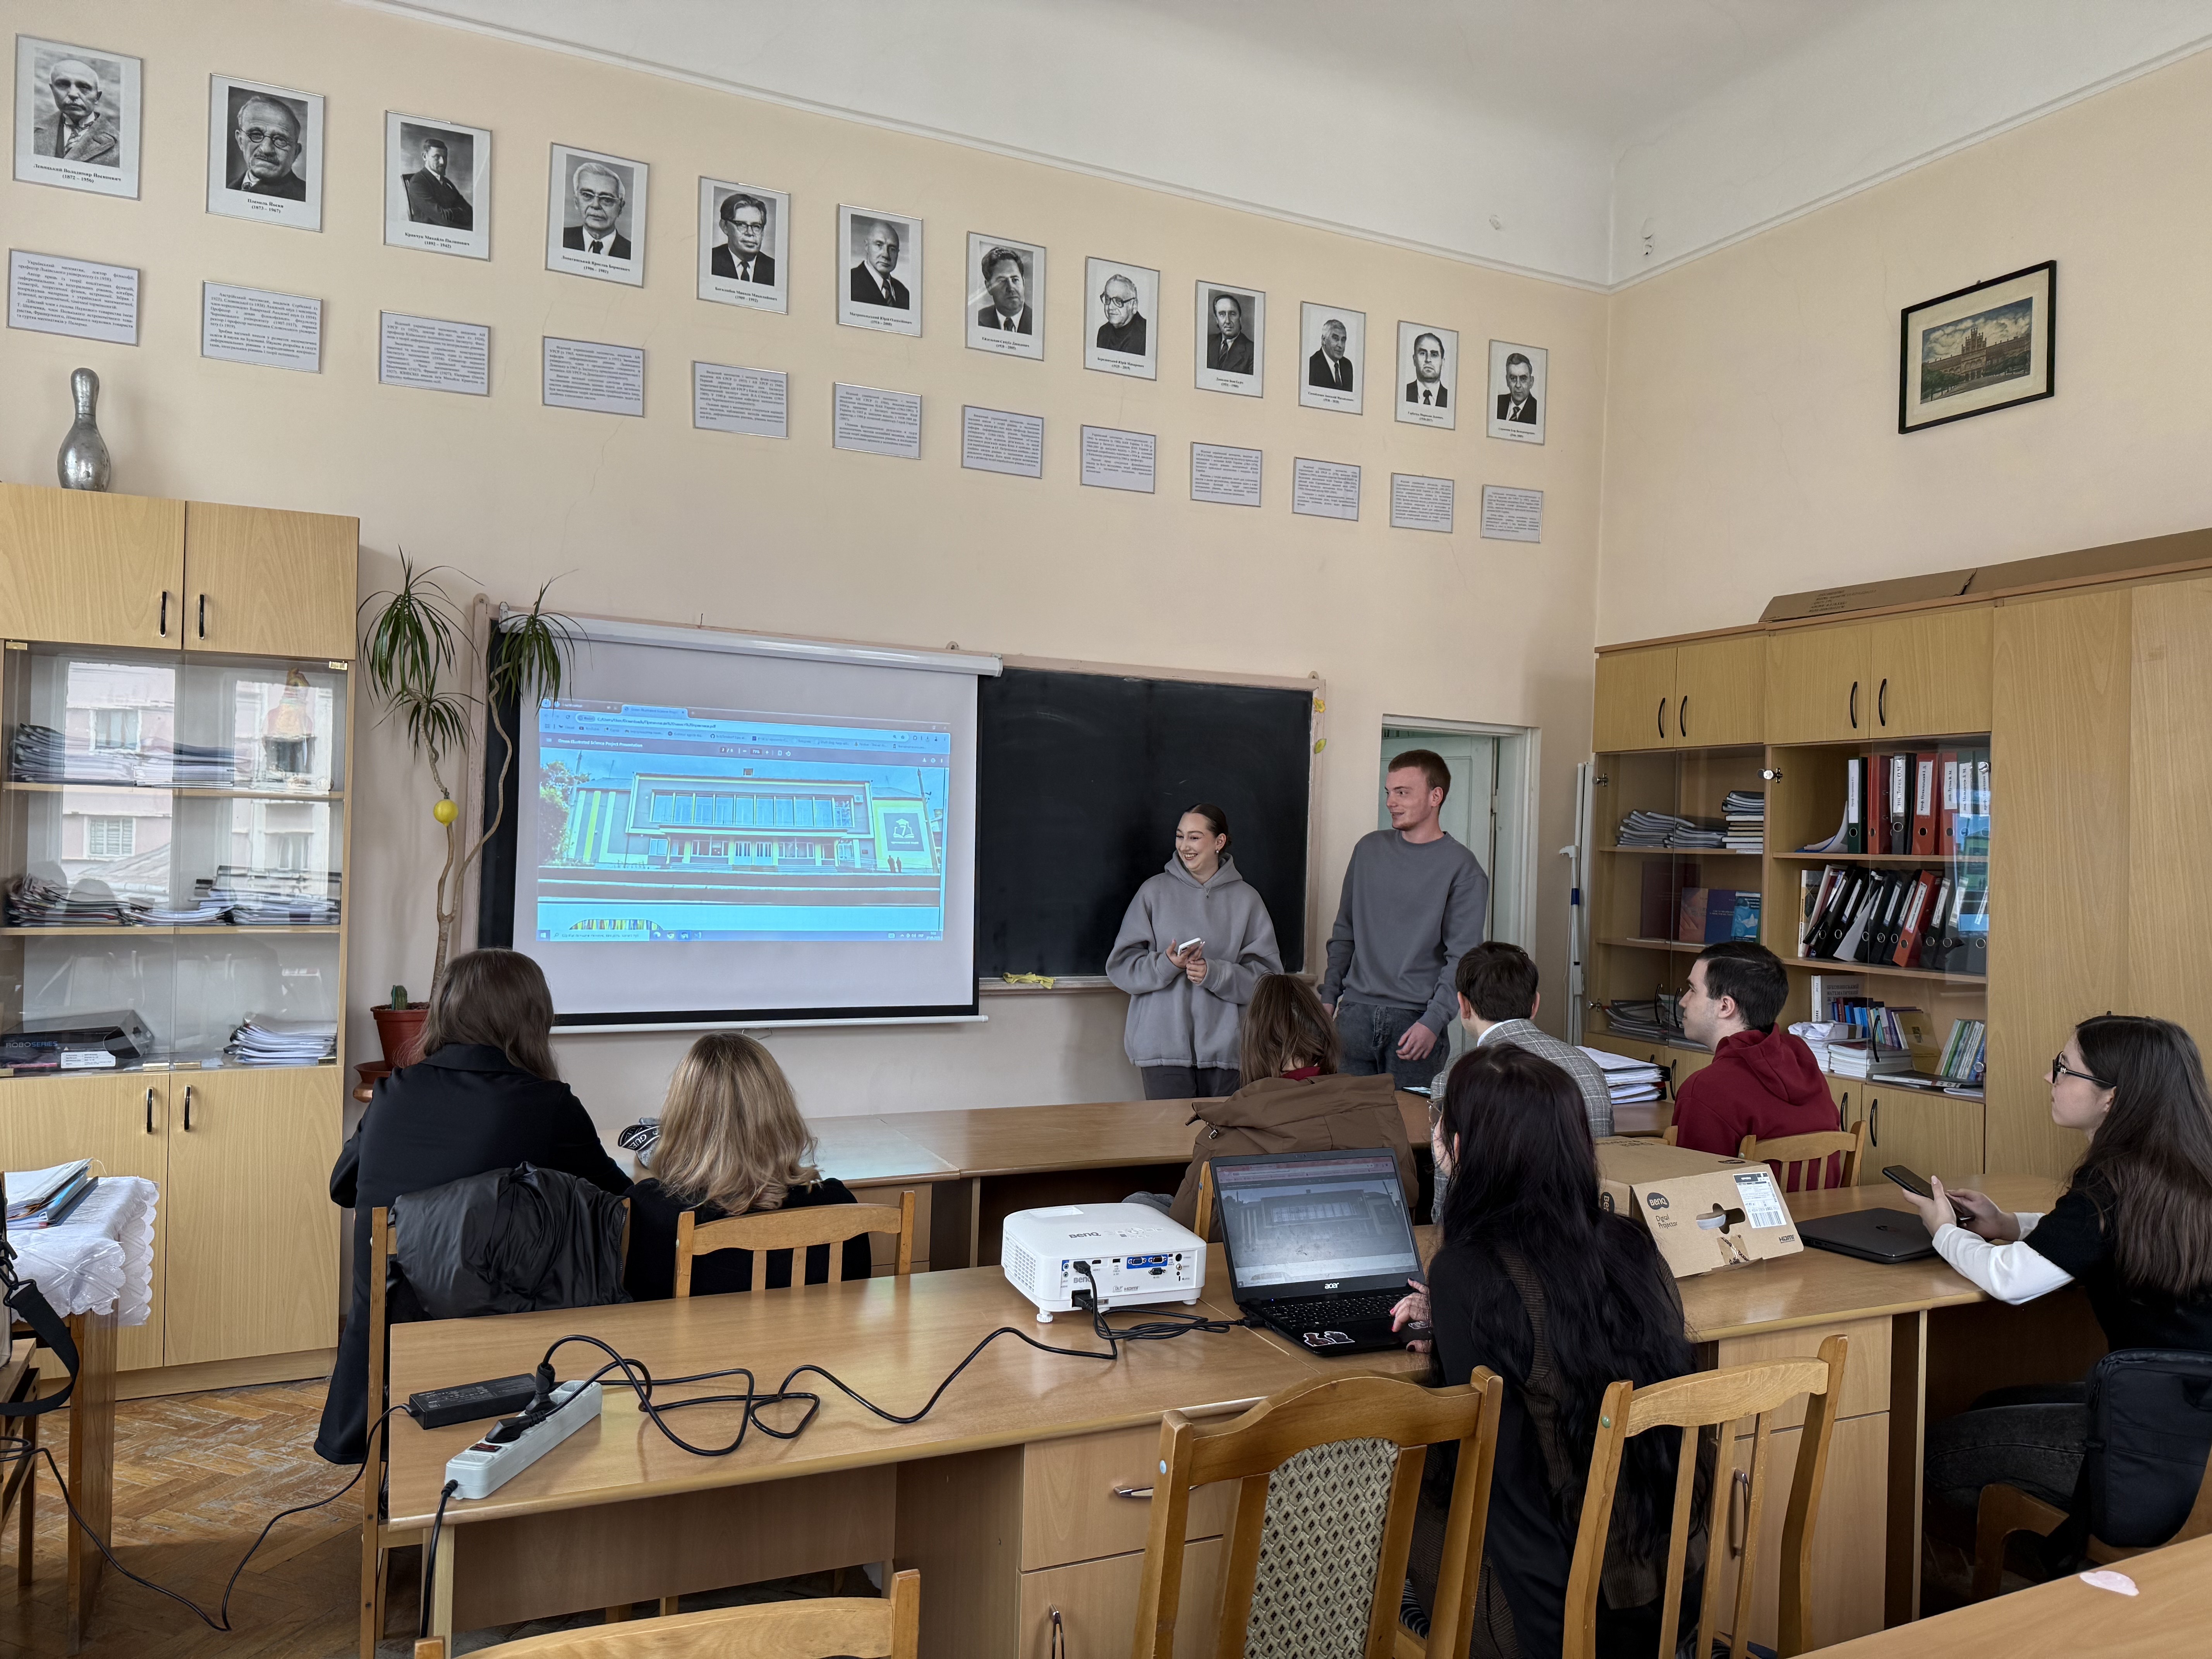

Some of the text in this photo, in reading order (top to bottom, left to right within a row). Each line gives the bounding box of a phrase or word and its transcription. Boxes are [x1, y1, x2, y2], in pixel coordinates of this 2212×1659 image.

[5, 1041, 58, 1049] ROBOSERIES
[1649, 1197, 1667, 1206] BenQ
[1656, 1214, 1669, 1223] Digital
